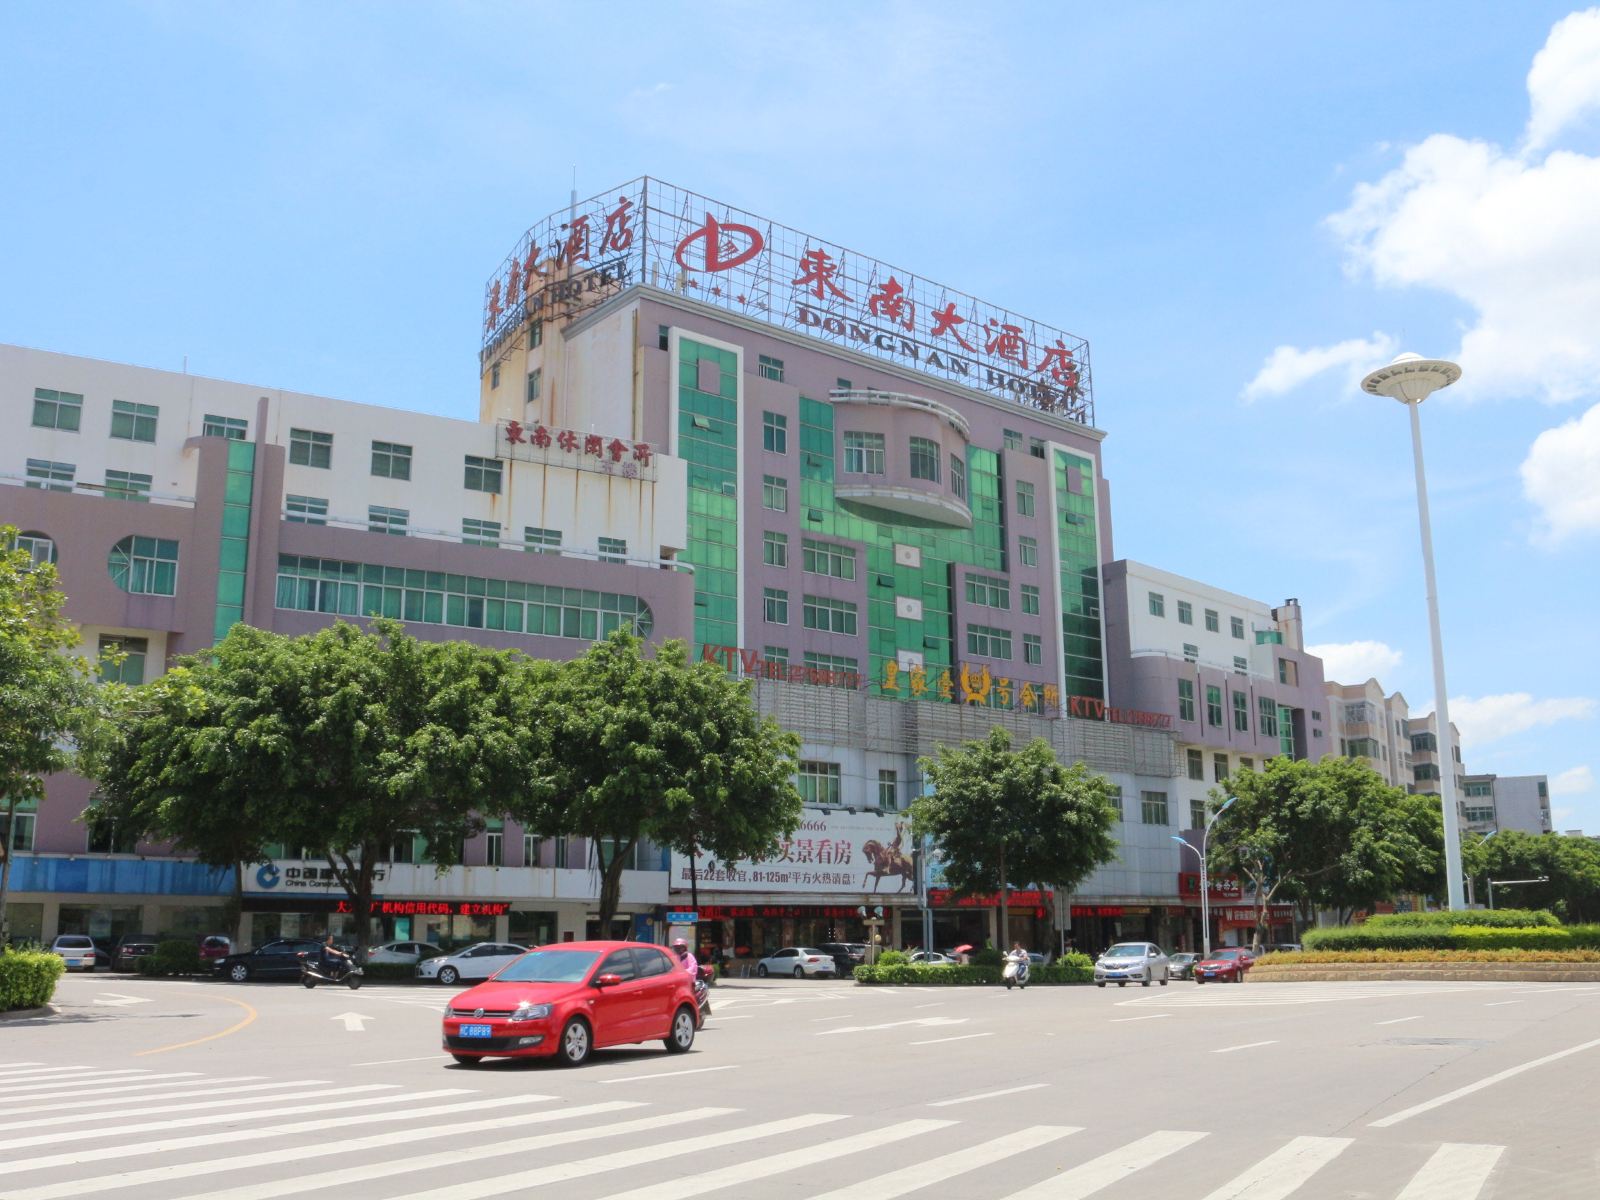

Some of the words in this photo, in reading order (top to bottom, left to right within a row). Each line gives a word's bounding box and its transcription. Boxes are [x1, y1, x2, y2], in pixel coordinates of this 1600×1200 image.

[799, 306, 969, 376] DONGNAN
[703, 643, 758, 674] KTV
[1070, 696, 1105, 719] KTV
